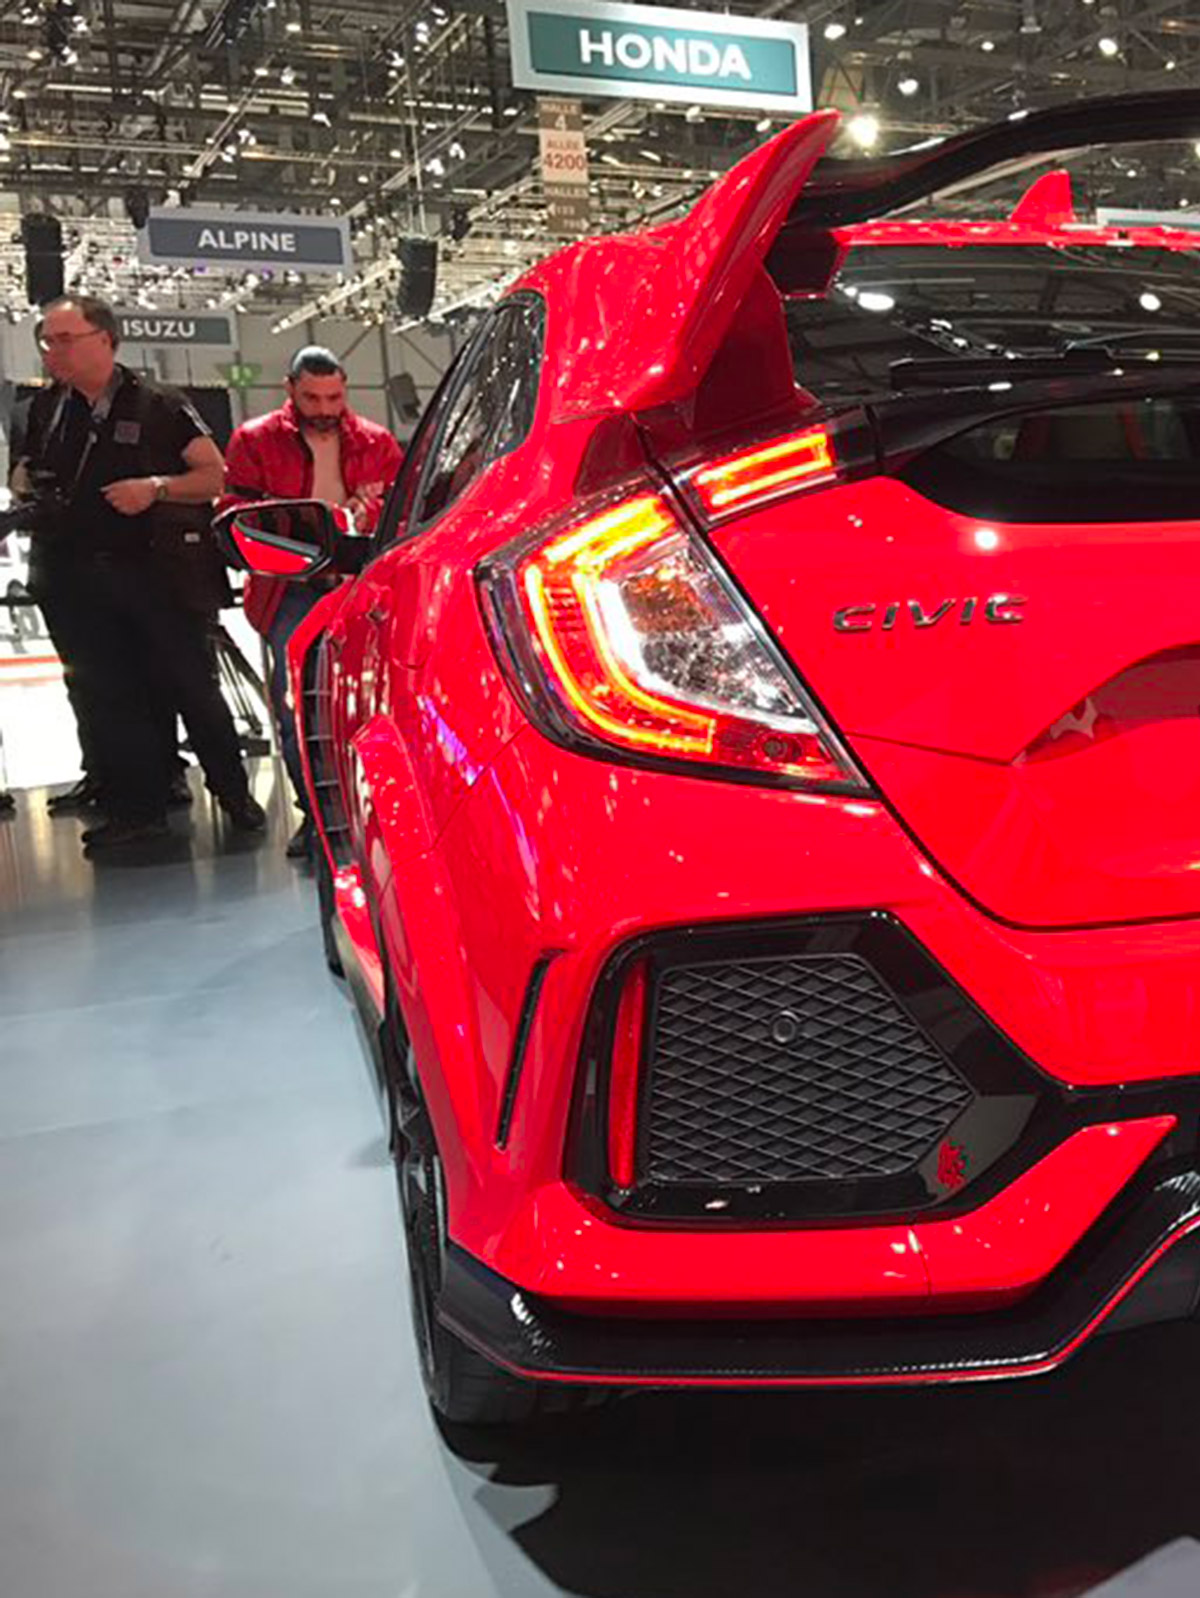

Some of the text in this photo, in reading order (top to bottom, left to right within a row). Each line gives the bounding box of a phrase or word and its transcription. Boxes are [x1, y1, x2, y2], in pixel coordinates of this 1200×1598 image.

[579, 29, 752, 81] HONDA
[544, 152, 586, 171] 4200
[198, 228, 296, 252] ALPINE
[122, 319, 195, 338] ISUZU
[833, 593, 1028, 632] CIVIC
